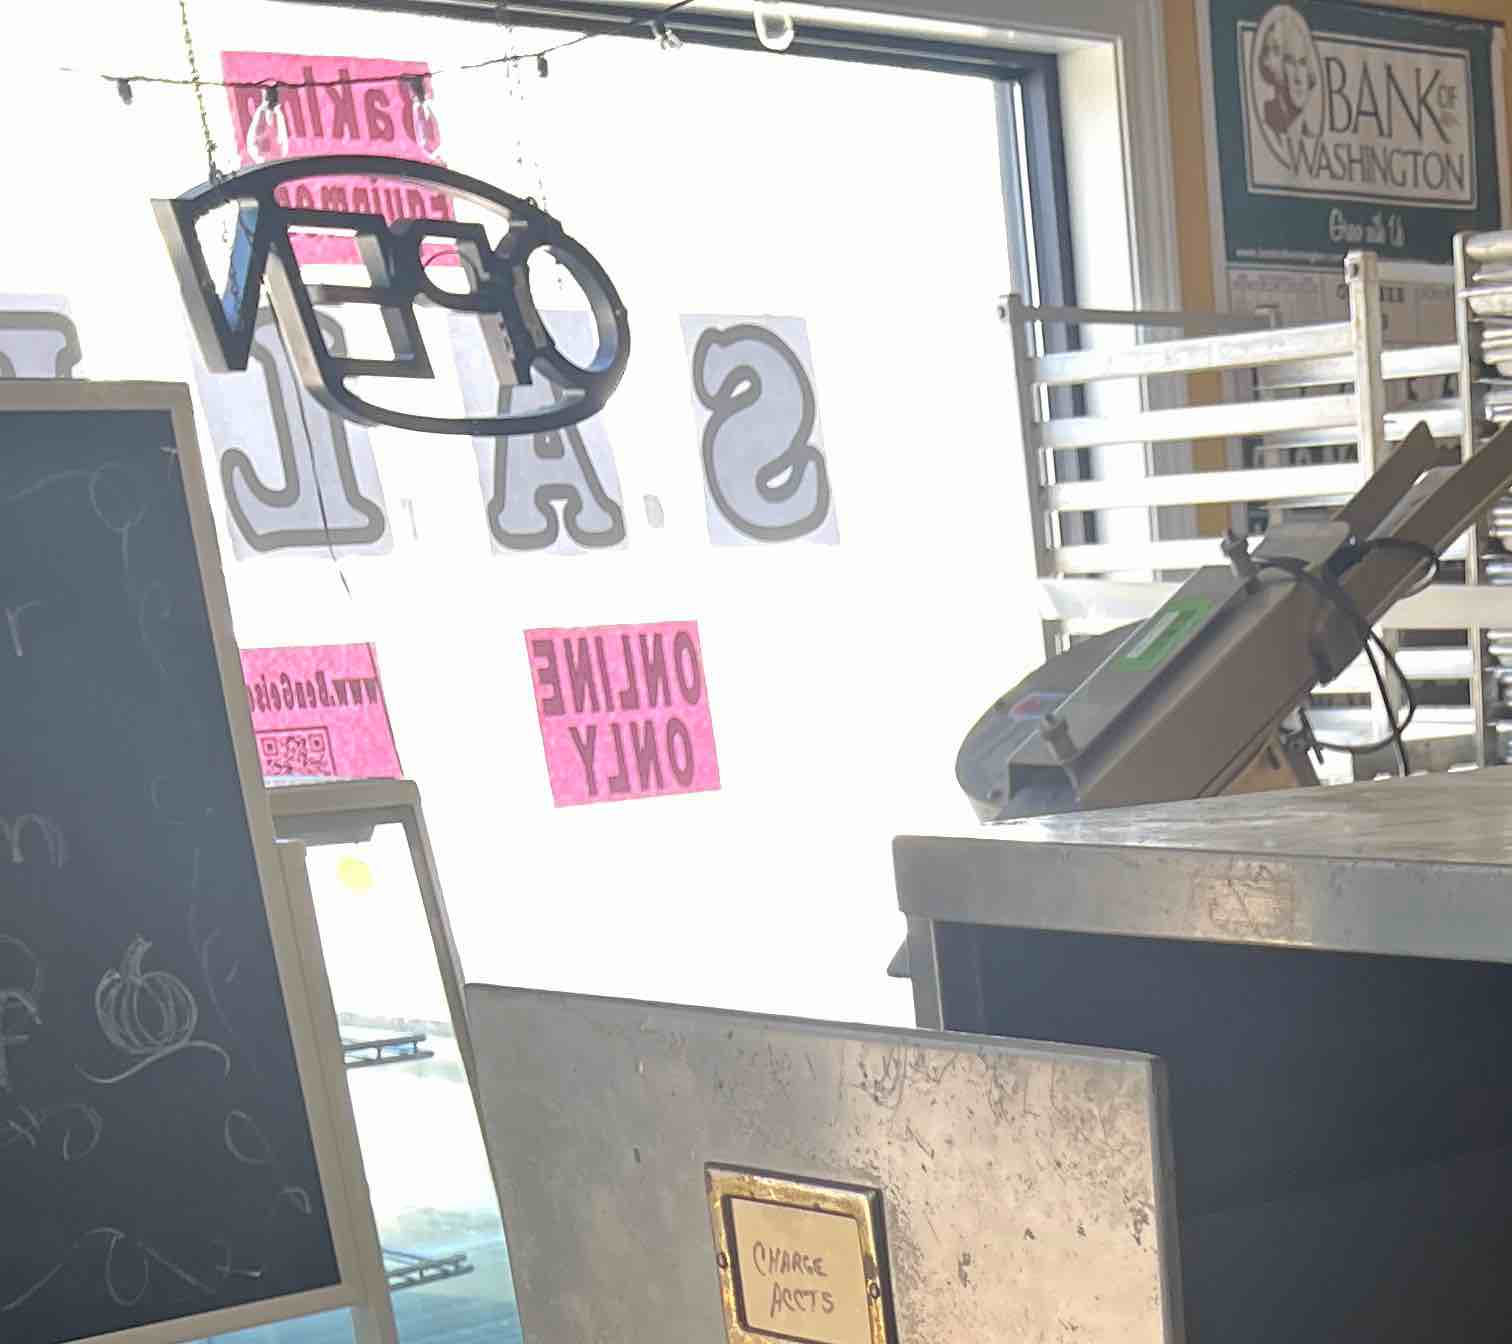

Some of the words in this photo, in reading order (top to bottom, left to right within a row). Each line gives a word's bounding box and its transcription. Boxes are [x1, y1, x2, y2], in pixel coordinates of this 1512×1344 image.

[1324, 56, 1451, 144] BANK
[1283, 132, 1465, 192] WASHINGTON
[752, 1240, 829, 1278] CHARGE
[770, 1281, 835, 1319] ACCTS
